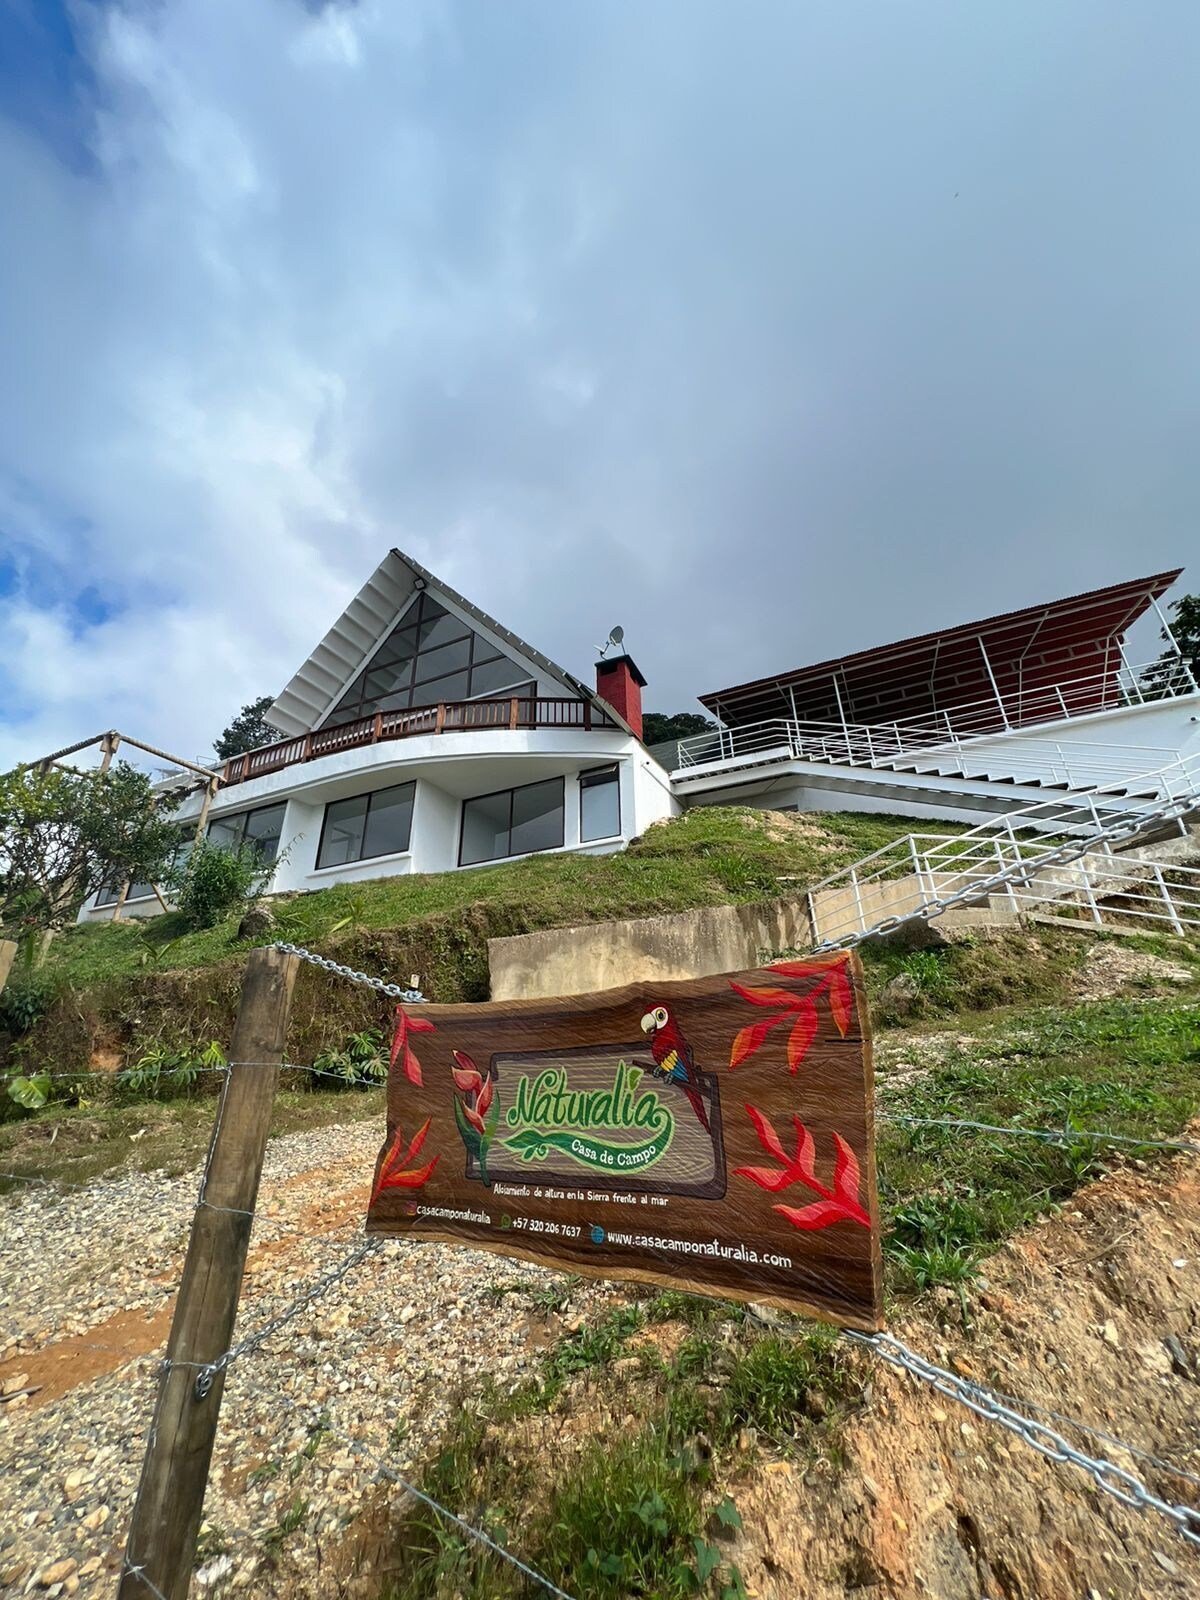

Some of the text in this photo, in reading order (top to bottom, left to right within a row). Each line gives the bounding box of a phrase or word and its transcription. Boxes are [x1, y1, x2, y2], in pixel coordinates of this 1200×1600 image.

[507, 1060, 663, 1129] Naturalia
[572, 1139, 656, 1166] Casa de Campo
[534, 1187, 542, 1197] de
[544, 1188, 564, 1199] altura
[578, 1190, 584, 1200] la
[587, 1191, 610, 1202] Sierra
[613, 1193, 636, 1204] frente
[640, 1195, 648, 1204] al
[651, 1196, 668, 1206] mar
[416, 1205, 491, 1224] casacamponaturalia
[512, 1218, 581, 1237] +57 320 206 7637
[608, 1232, 792, 1268] www.casacamponaturalia.com
